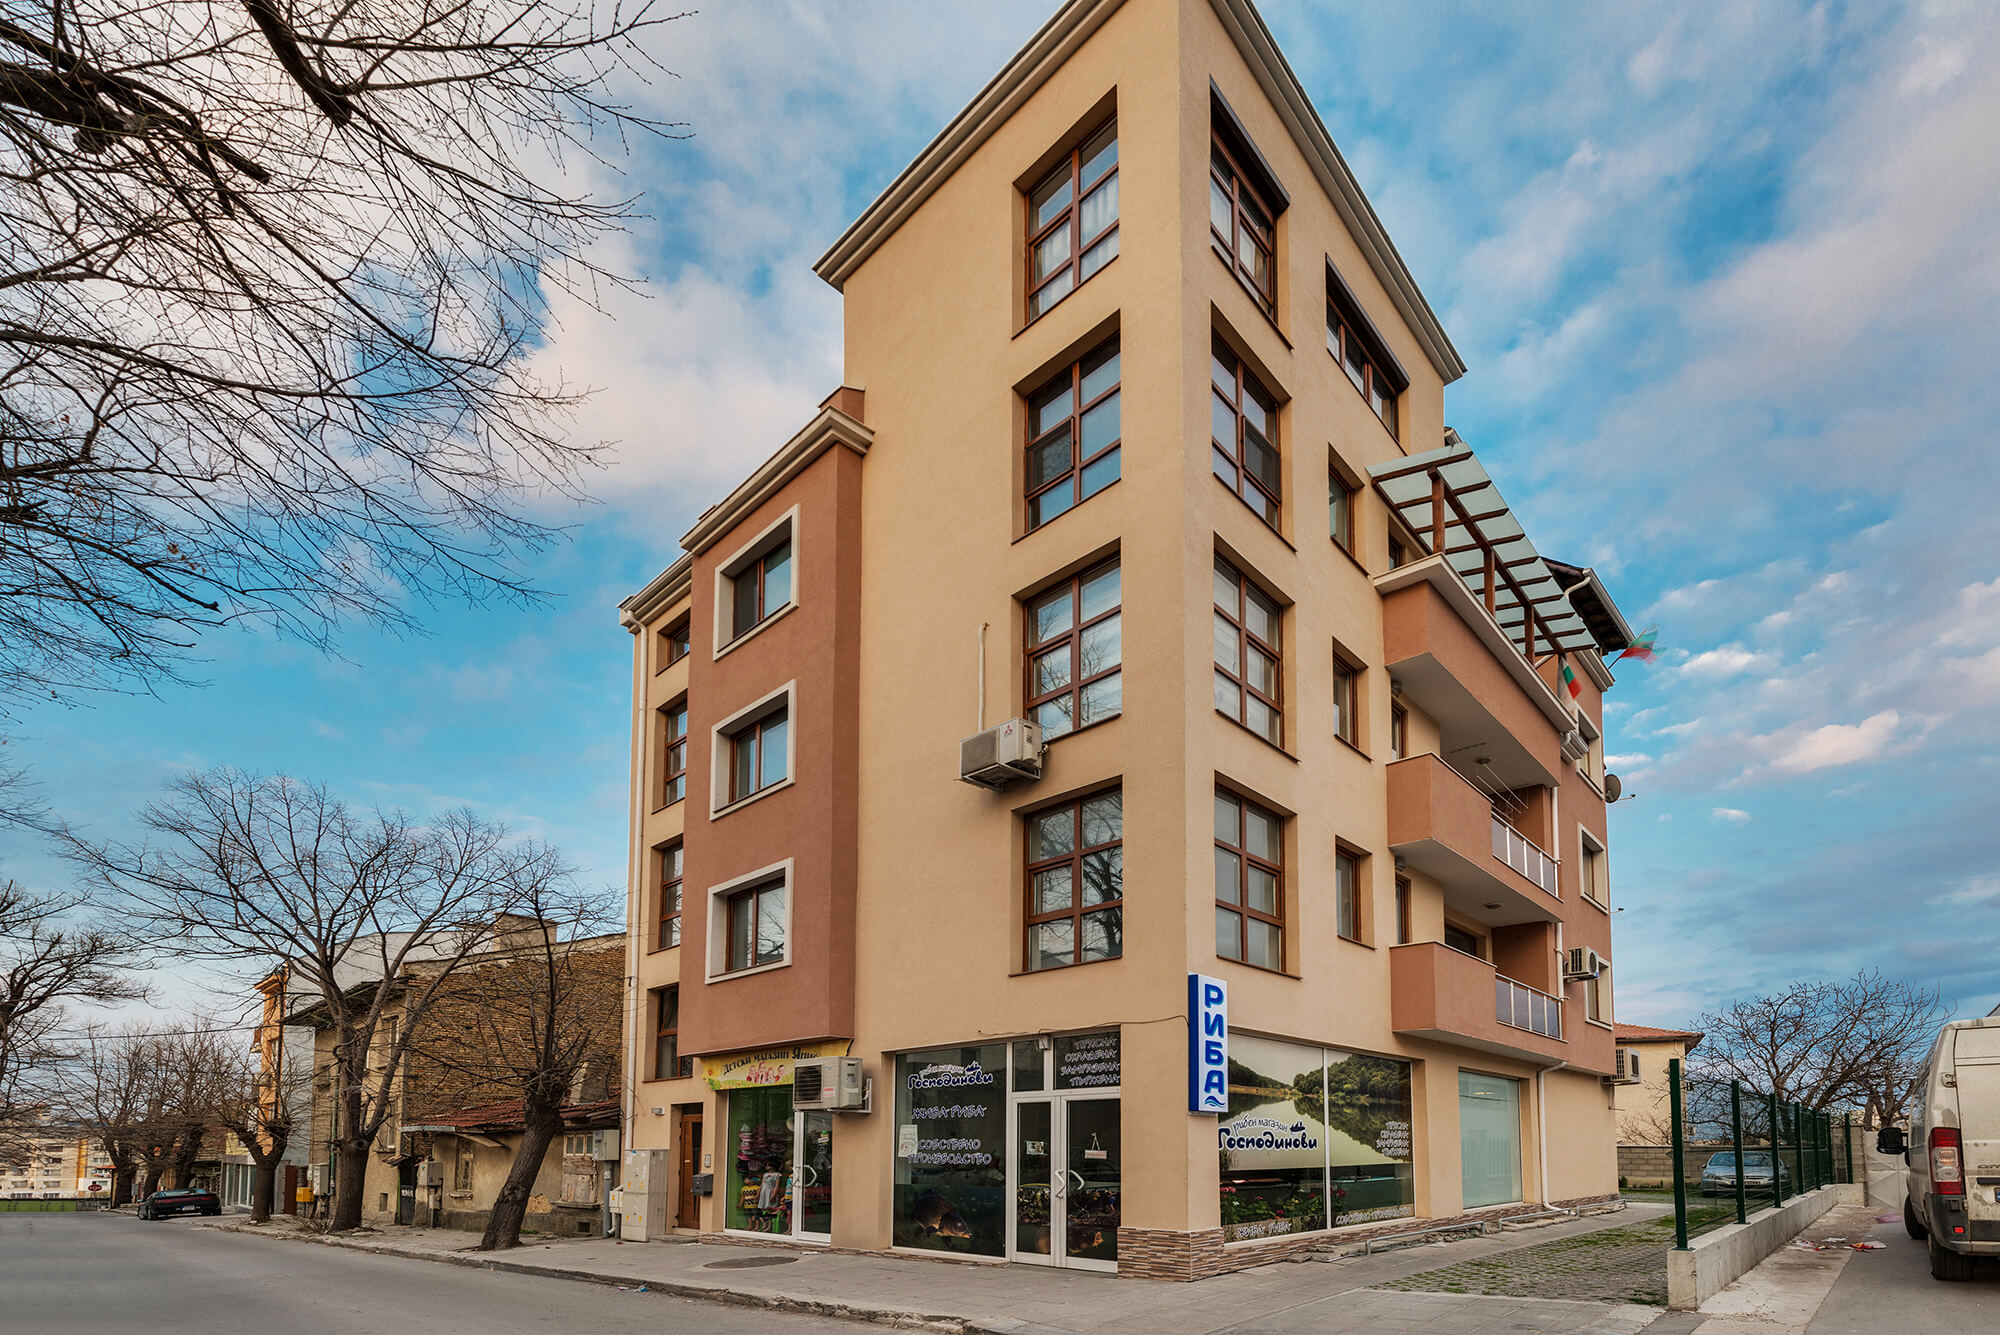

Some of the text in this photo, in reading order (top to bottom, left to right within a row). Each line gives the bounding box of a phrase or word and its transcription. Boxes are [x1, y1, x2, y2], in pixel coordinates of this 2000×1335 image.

[1203, 983, 1225, 1096] РИБА
[908, 1071, 993, 1089] Господинови
[912, 1104, 987, 1119] ЖИВА РИБА
[1233, 1115, 1288, 1136] рибен магазин
[1218, 1128, 1318, 1150] Господинови
